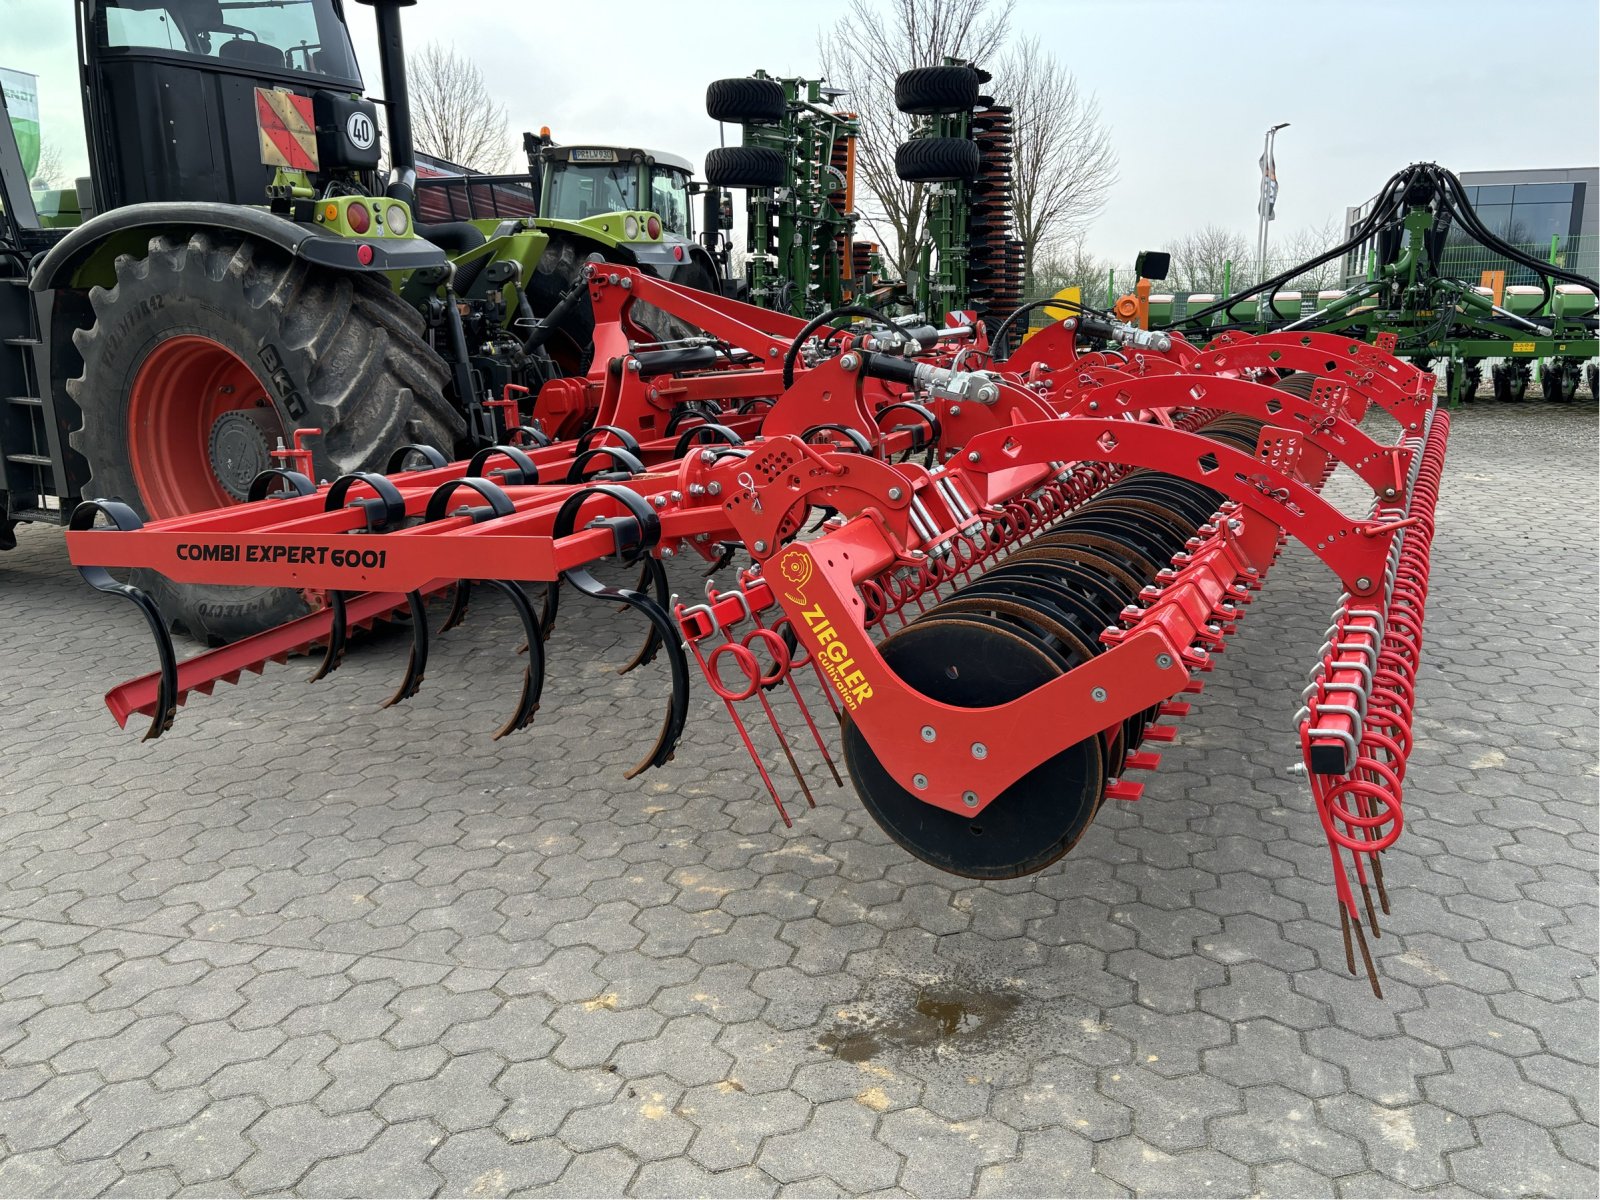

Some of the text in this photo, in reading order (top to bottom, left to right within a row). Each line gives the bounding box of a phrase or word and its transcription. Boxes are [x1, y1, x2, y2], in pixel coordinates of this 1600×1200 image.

[353, 118, 369, 143] 40
[257, 344, 309, 421] BKT
[176, 544, 386, 569] COMBI EXPERT 6001
[801, 602, 873, 705] ZIEGLER
[817, 651, 857, 711] Cultivation
